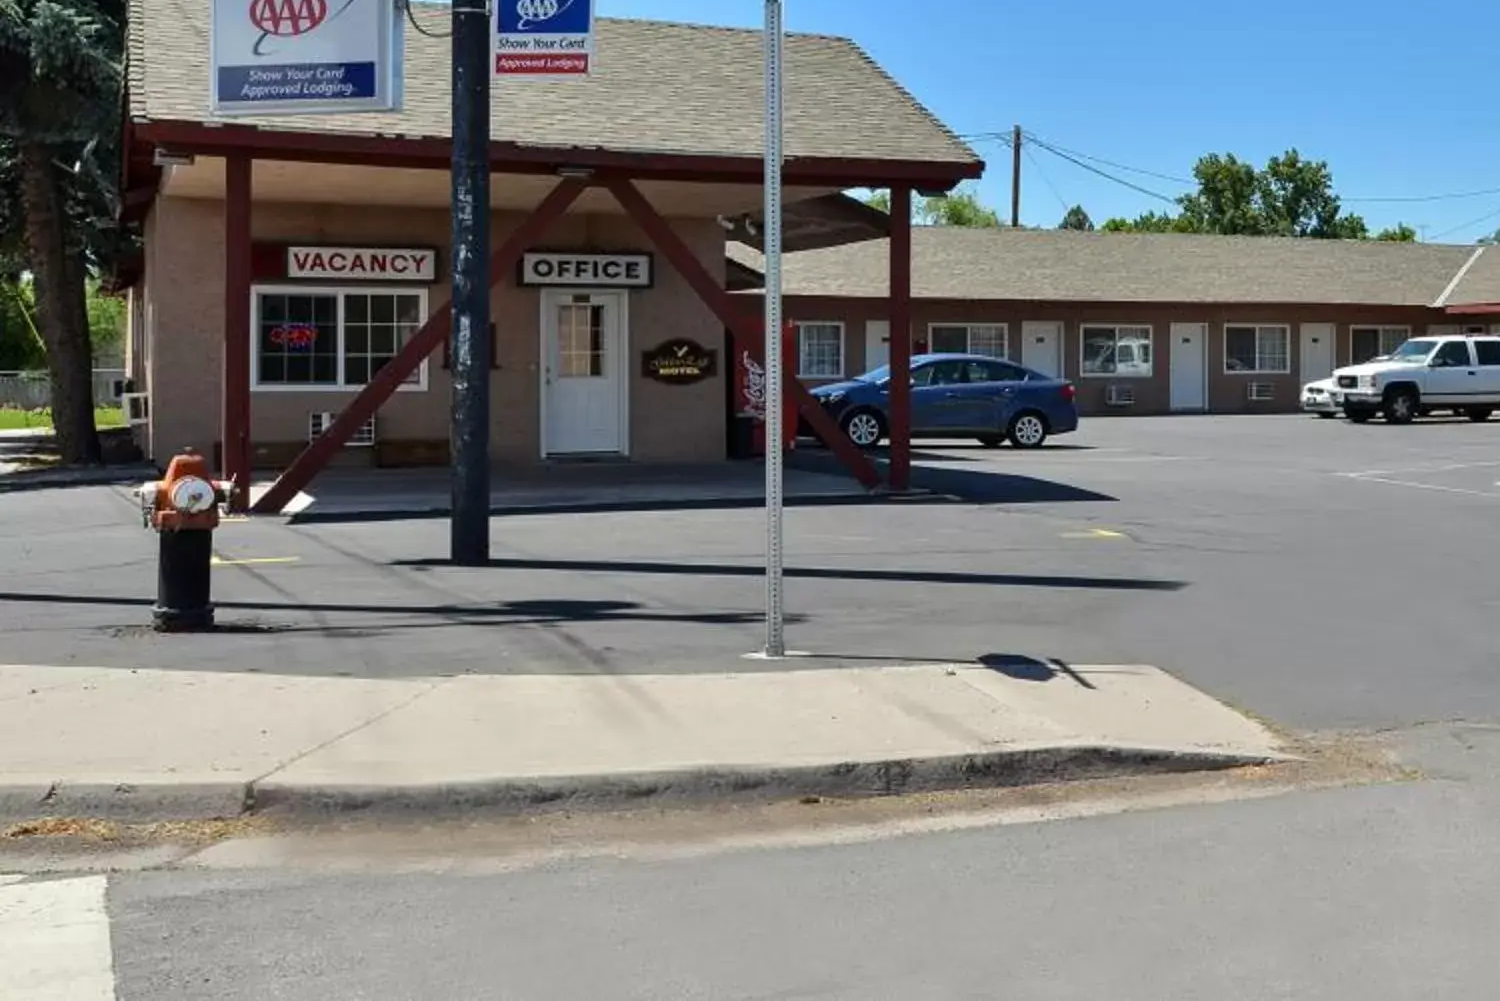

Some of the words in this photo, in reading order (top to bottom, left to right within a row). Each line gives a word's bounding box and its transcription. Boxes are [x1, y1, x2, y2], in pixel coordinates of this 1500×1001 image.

[499, 39, 529, 49] Show
[533, 39, 557, 49] Your
[560, 38, 585, 49] Card
[250, 69, 282, 81] Show
[286, 68, 313, 80] Your
[316, 67, 345, 79] Card
[241, 83, 300, 98] Approved
[293, 252, 428, 274] VACANCY
[531, 258, 641, 280] OFFICE
